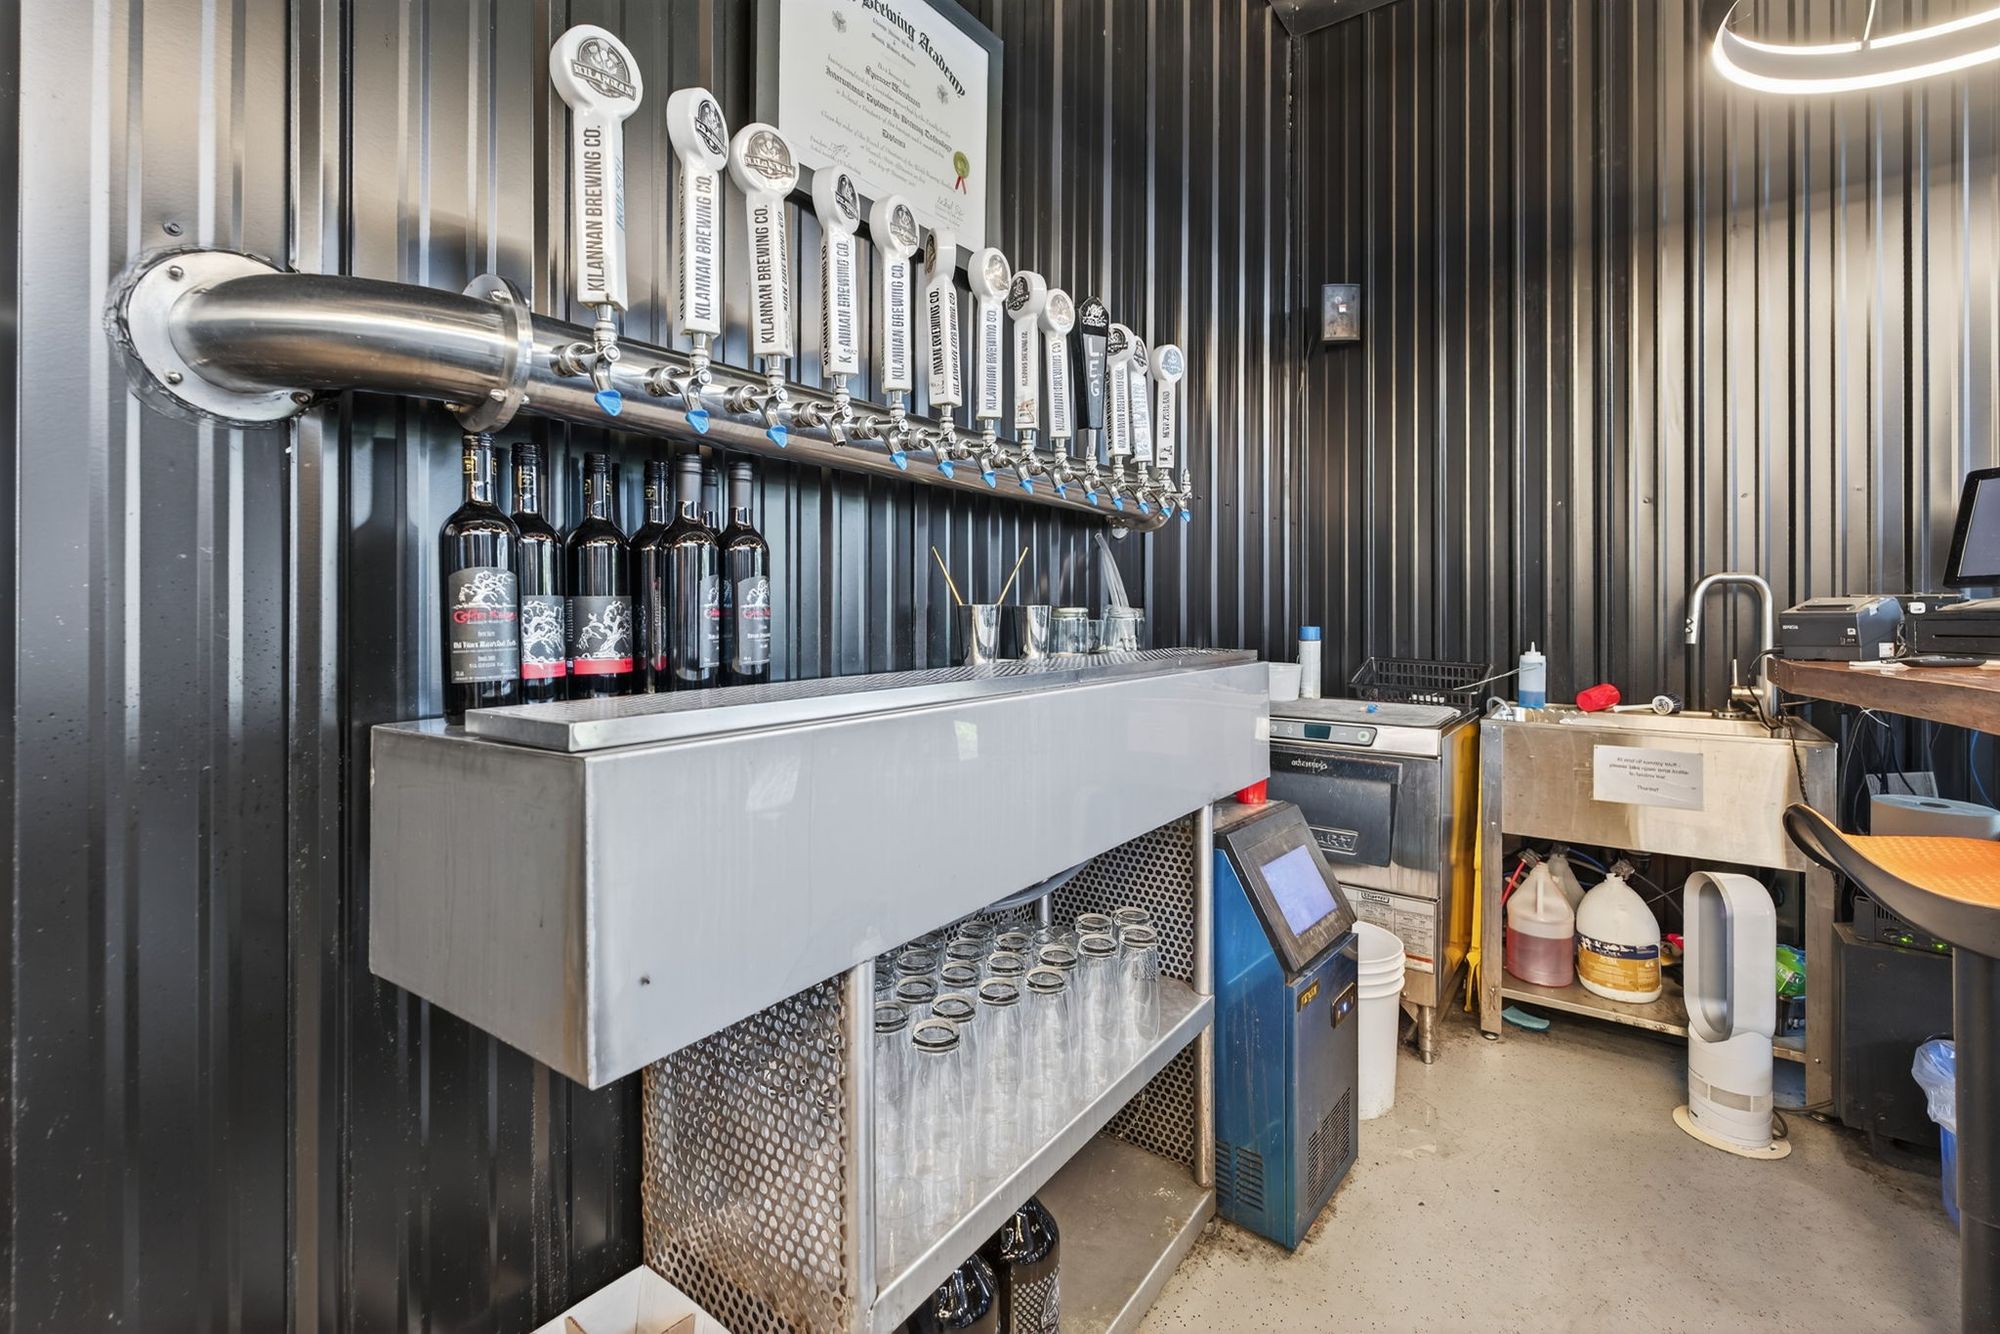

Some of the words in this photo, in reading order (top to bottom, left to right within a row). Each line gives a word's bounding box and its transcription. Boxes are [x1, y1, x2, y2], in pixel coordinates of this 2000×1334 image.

[918, 32, 966, 97] Academy
[583, 125, 602, 148] CO.
[584, 151, 602, 216] BREWING
[696, 175, 712, 194] CO.
[696, 197, 711, 255] BREWING
[754, 204, 769, 224] CO.
[586, 220, 605, 292] KILANNAN
[755, 226, 771, 281] BREWING
[695, 256, 712, 321] KILANNAN
[837, 260, 851, 308] BREWING
[891, 280, 905, 327] BREWING
[758, 284, 775, 343] KILANNAN
[838, 309, 852, 364] KANNAN
[930, 305, 942, 346] BREWING
[891, 330, 905, 380] KILANNAN
